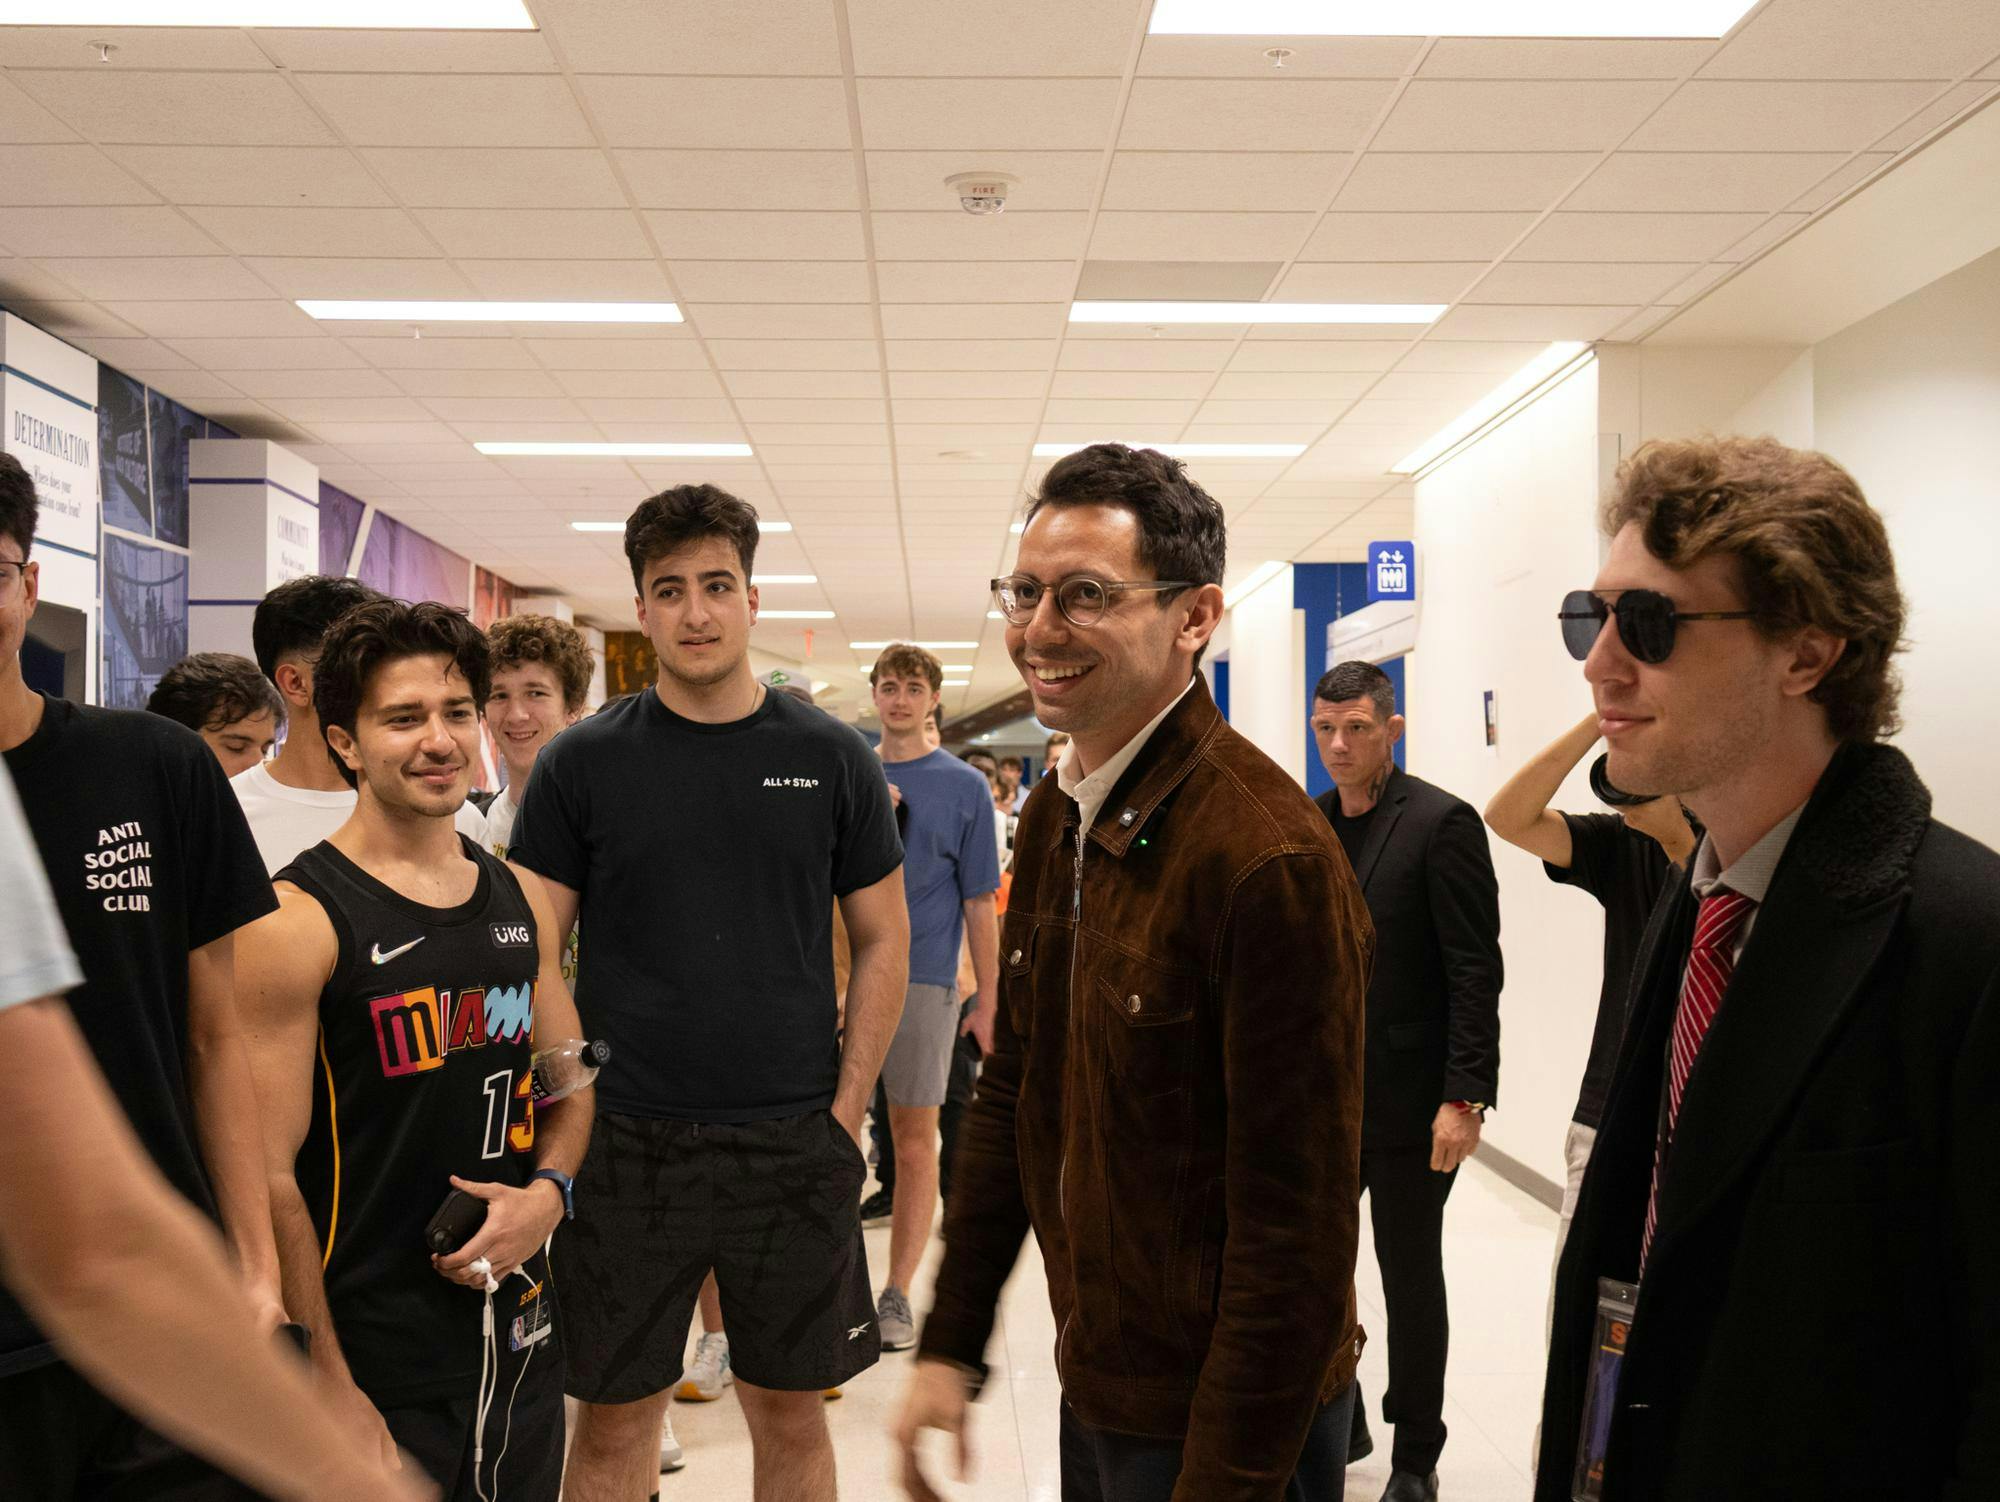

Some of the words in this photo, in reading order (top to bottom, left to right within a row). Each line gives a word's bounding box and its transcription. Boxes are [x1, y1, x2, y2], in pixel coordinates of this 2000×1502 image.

[14, 410, 90, 468] DETERMINATION
[762, 777, 783, 787] ALL
[97, 821, 142, 846] ANTI
[84, 841, 152, 869] SOCIAL
[86, 865, 153, 890] SOCIAL
[103, 894, 151, 912] CLUB
